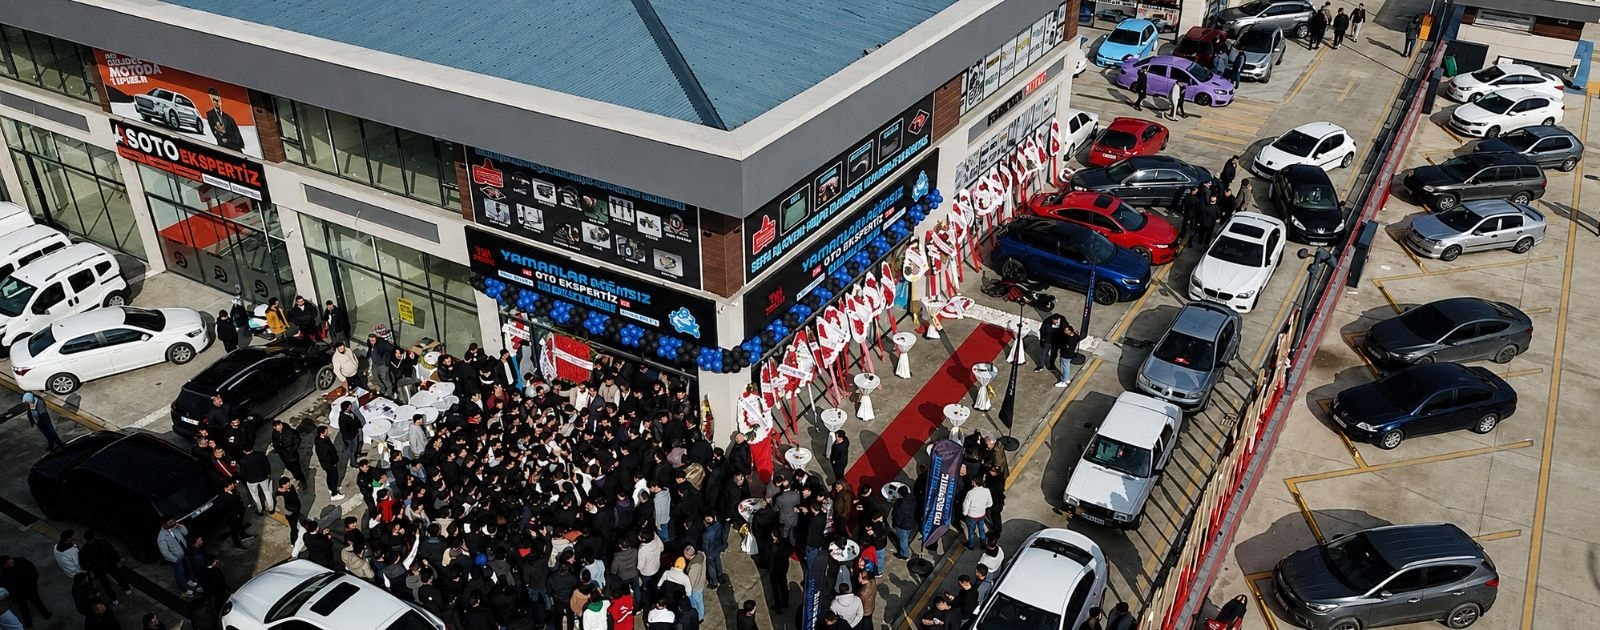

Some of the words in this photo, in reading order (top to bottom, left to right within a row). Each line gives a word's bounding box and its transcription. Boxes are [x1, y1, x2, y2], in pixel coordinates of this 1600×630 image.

[179, 148, 261, 187] EKSPERTİZ
[500, 249, 588, 285] YAMANLAR
[823, 247, 842, 266] OTO
[535, 271, 557, 284] OTO
[559, 277, 618, 304] EKSPERTİZ
